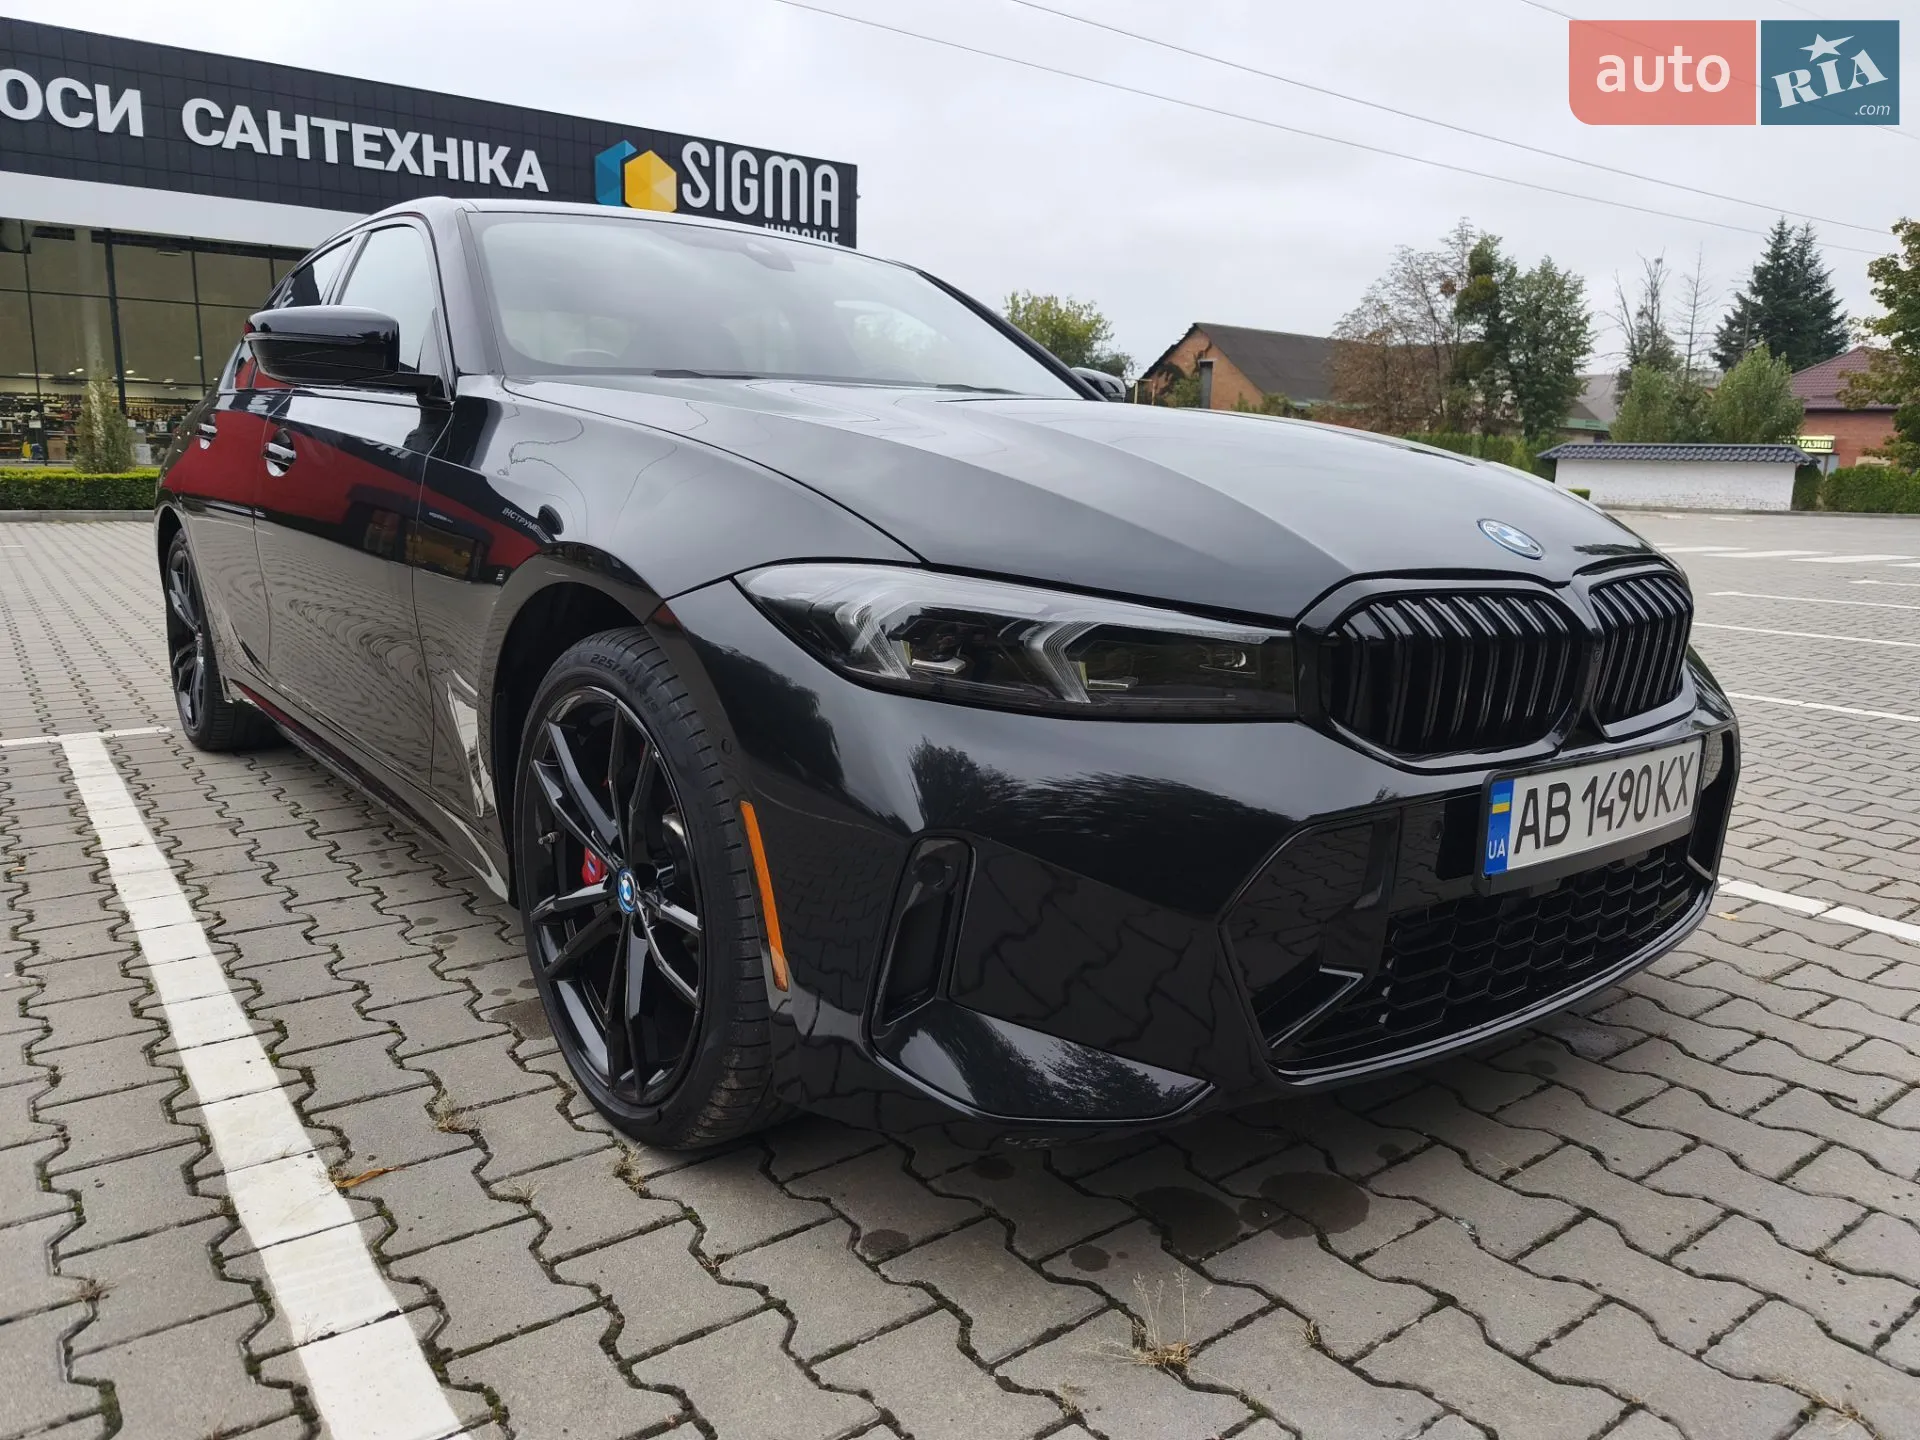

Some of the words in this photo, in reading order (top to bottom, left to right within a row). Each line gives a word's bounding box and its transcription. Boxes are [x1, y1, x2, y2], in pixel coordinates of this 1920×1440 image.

[181, 98, 549, 192] САНТЕХНІКА
[681, 141, 840, 228] SIGMA
[1488, 837, 1506, 859] UA
[1513, 782, 1571, 854] AB
[1581, 764, 1652, 837] 1490
[1653, 752, 1695, 818] KX
